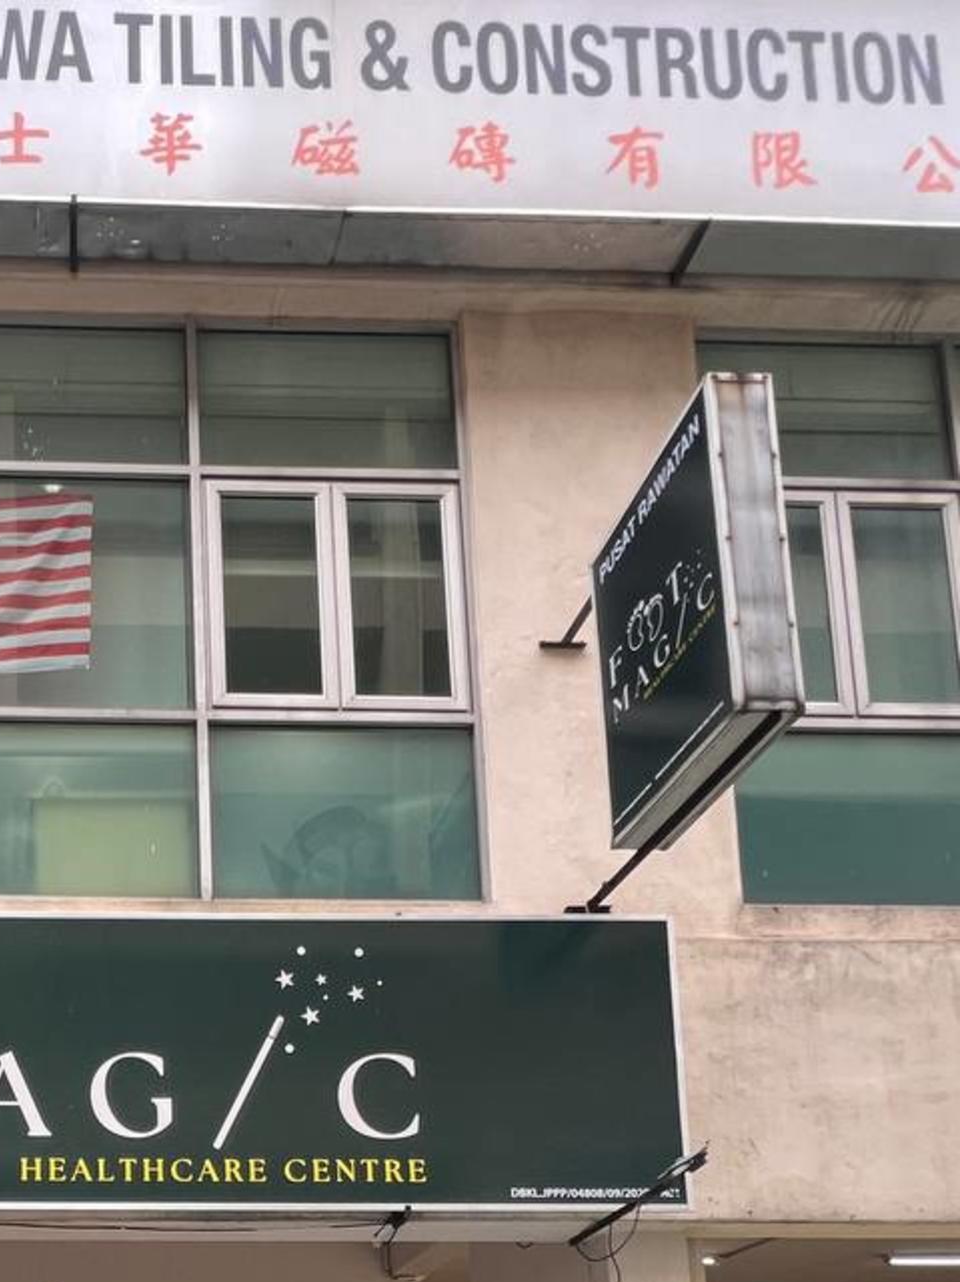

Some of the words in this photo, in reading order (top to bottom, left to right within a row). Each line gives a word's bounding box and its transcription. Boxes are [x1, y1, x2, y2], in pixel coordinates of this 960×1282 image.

[114, 12, 332, 90] TILING
[360, 19, 410, 92] &
[430, 20, 945, 106] CONSTRUCTION
[599, 514, 636, 585] PUSAT
[637, 414, 701, 525] RAWATAN
[19, 1157, 266, 1184] HEALTHCARE
[284, 1159, 428, 1184] CENTRE
